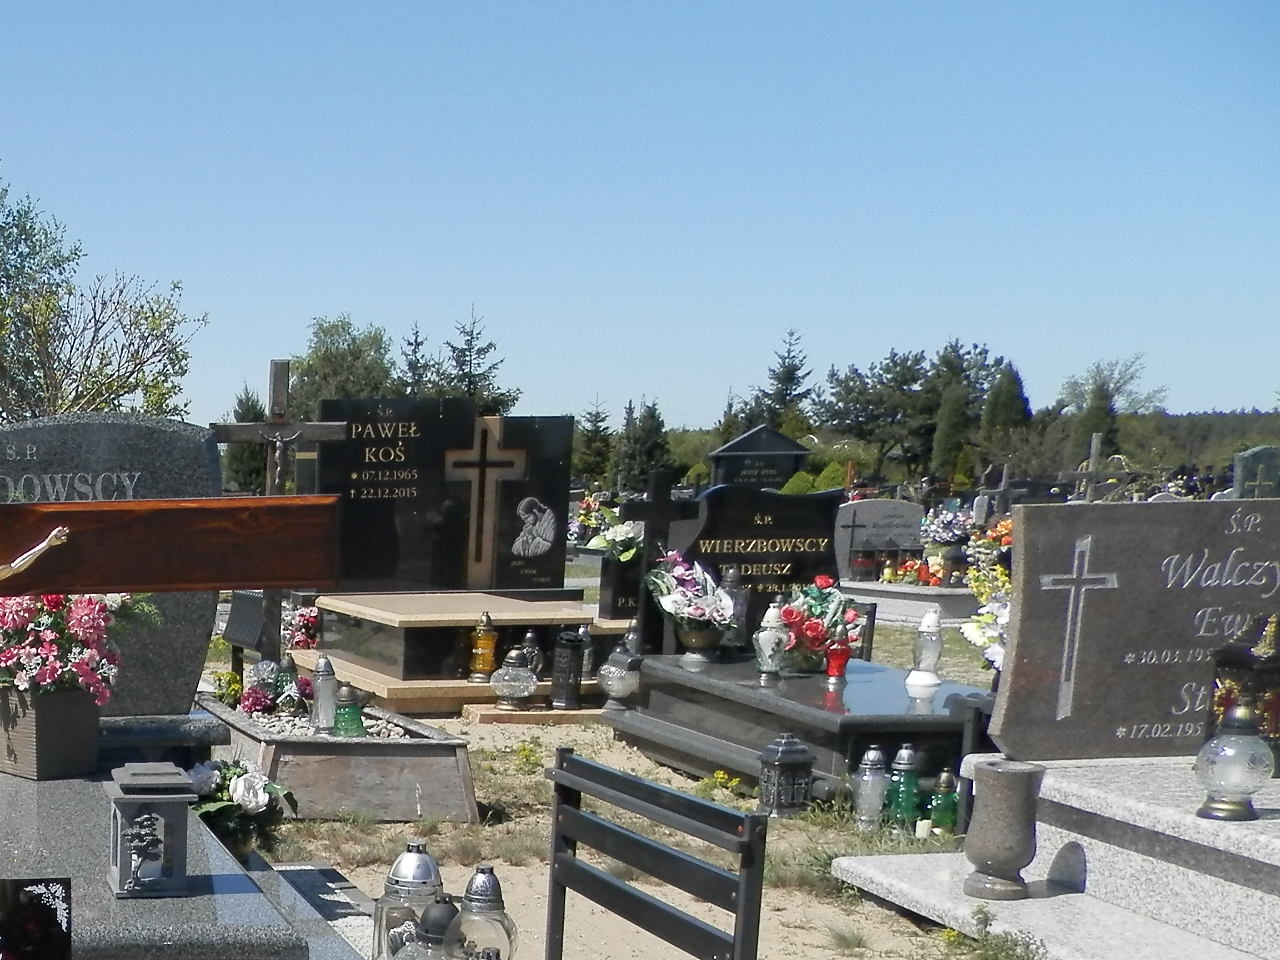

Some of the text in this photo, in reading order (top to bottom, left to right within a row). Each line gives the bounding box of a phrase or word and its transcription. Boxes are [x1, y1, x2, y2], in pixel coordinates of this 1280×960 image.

[351, 422, 421, 439] PAWEŁ
[365, 441, 405, 463] KOŚ
[362, 469, 419, 480] 07.12.1965
[360, 487, 418, 499] 22.12.2015
[700, 538, 829, 554] WIERZBOWSCY
